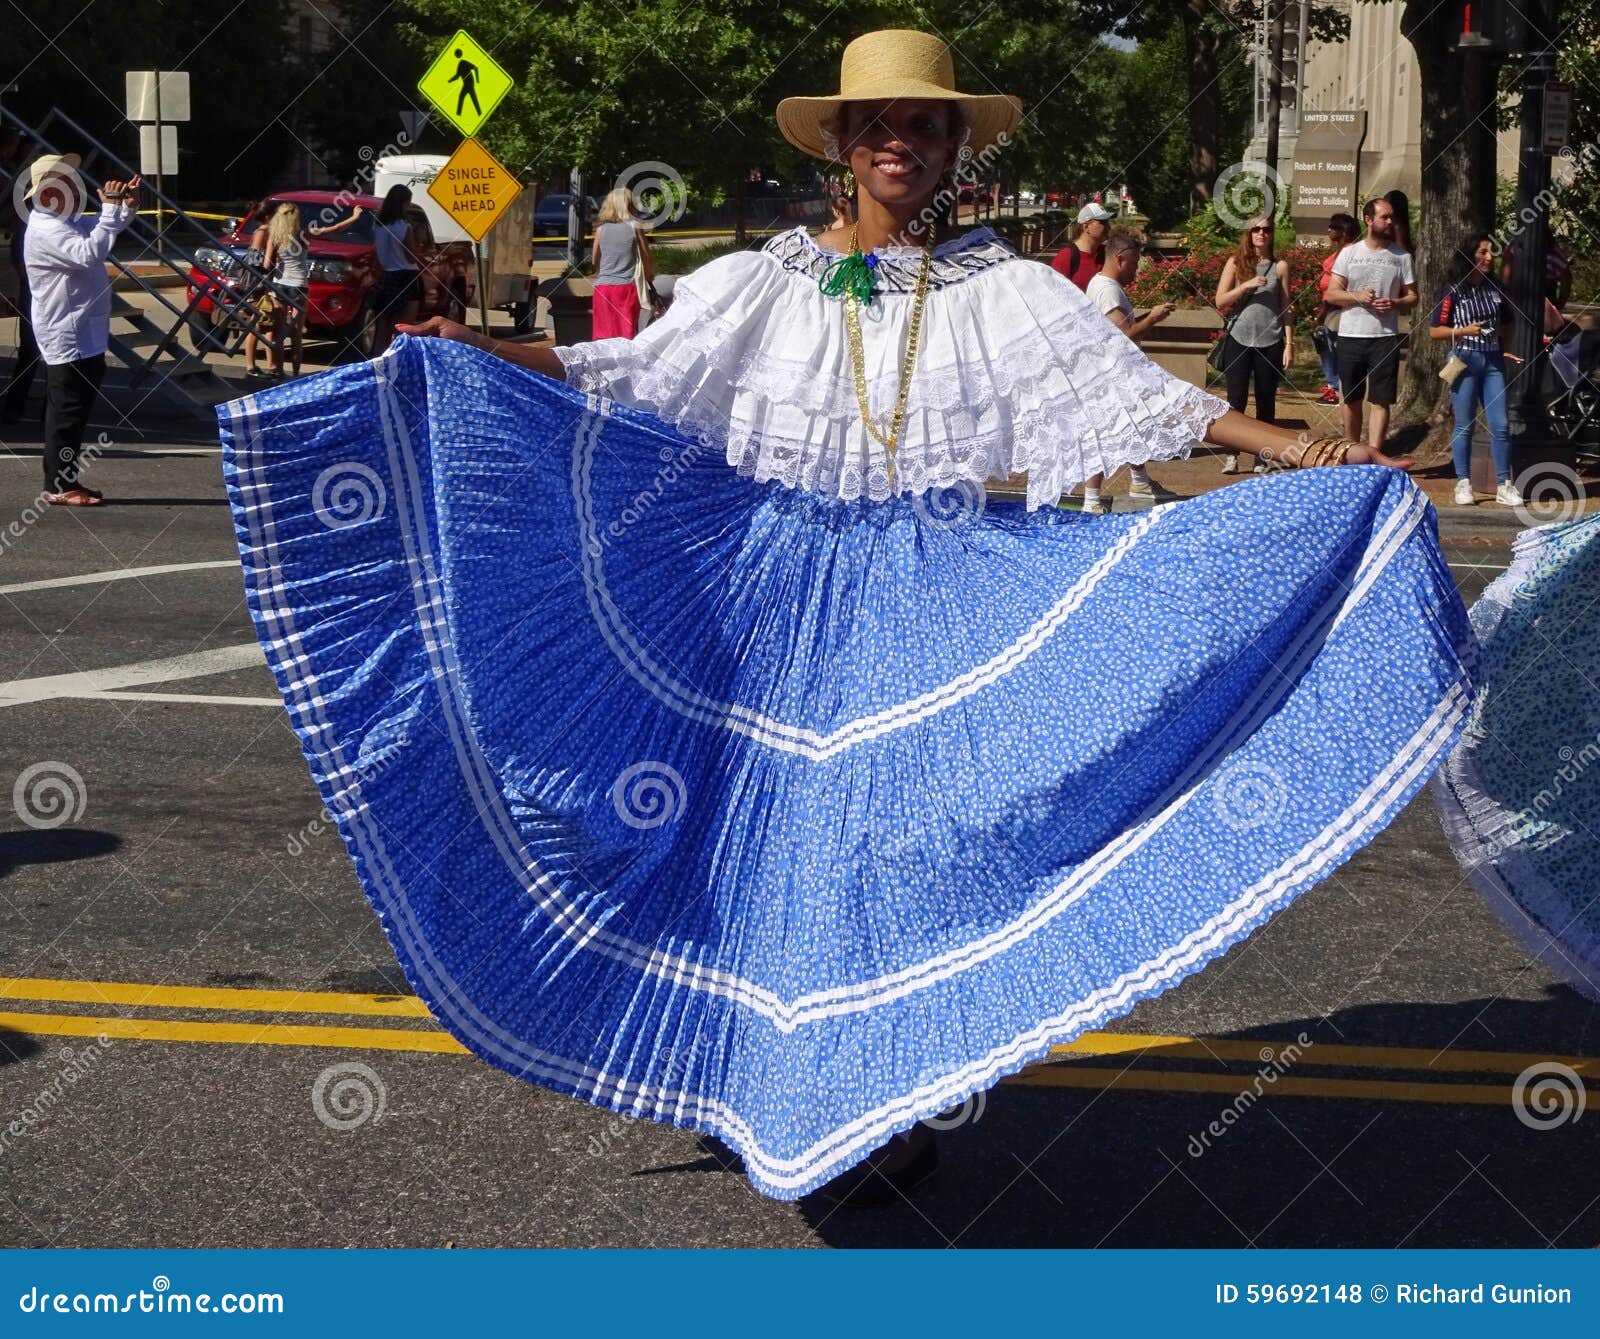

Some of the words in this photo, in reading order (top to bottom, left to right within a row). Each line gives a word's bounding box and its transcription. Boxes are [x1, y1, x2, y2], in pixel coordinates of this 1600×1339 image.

[1304, 114, 1329, 122] UNITED
[1330, 114, 1355, 122] STATES
[1294, 162, 1317, 171] Robert
[1318, 162, 1325, 171] F.
[1326, 162, 1356, 173] Kennedy
[448, 167, 496, 180] SINGLE
[454, 183, 491, 196] LANE
[1299, 185, 1338, 196] Department
[1340, 186, 1348, 195] of
[452, 199, 496, 212] AHEAD
[1297, 197, 1320, 206] Justice
[1322, 197, 1349, 207] Building
